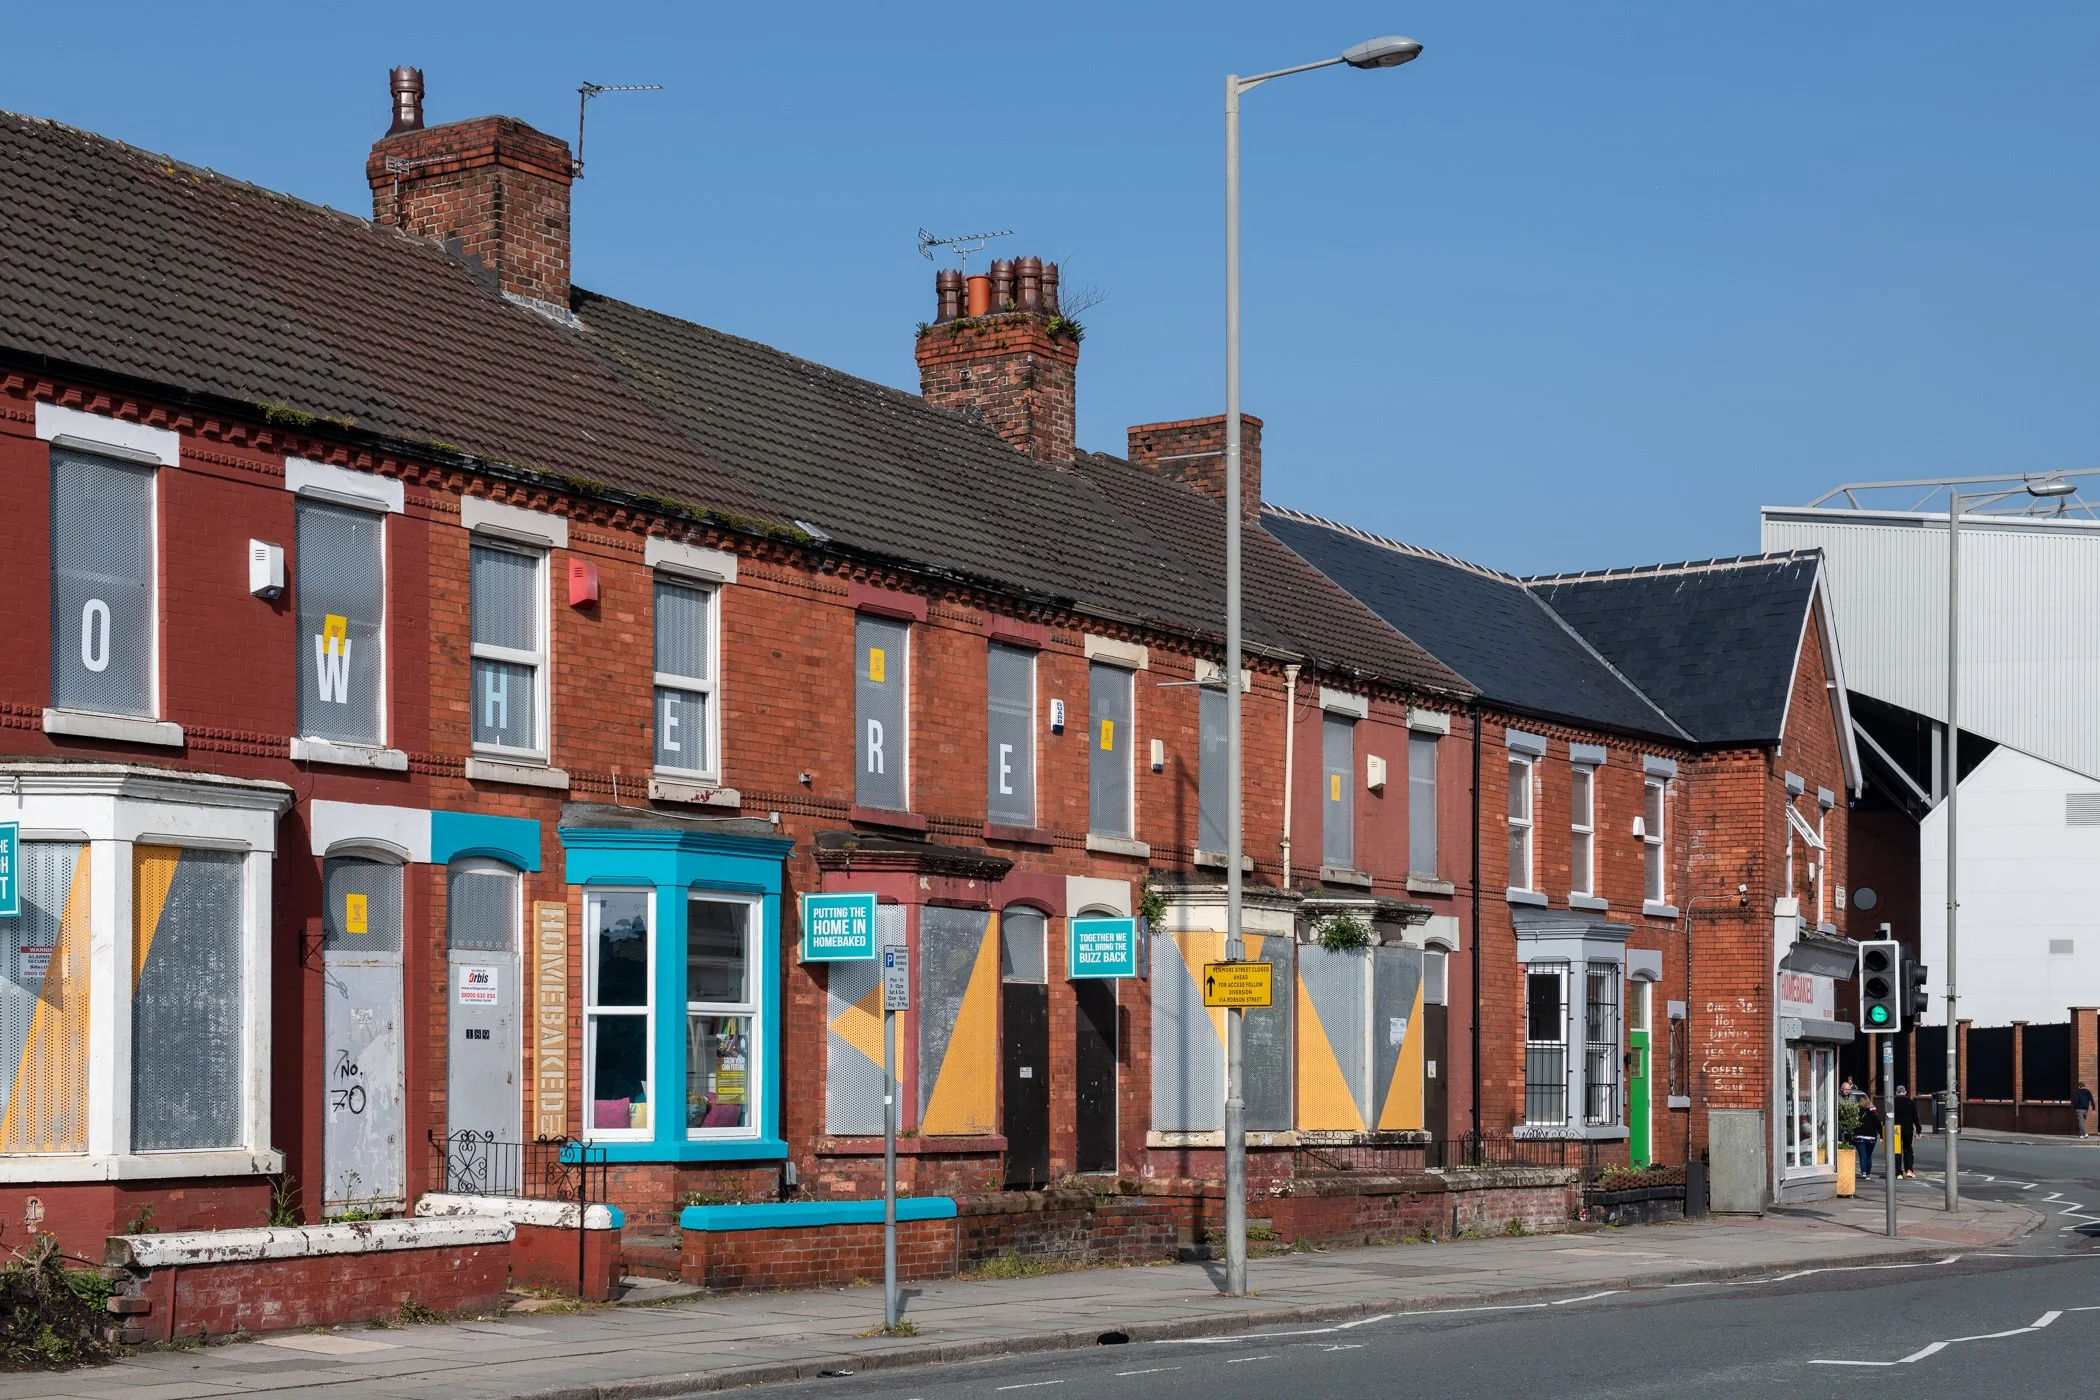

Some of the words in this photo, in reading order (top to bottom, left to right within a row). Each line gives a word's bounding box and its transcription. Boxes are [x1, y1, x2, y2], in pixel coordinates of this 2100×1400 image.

[81, 598, 110, 672] O
[315, 634, 352, 703] W
[485, 662, 508, 729] H
[663, 691, 681, 751] E
[867, 719, 884, 774] R
[1000, 743, 1013, 795] E
[813, 907, 848, 919] PUTTING
[849, 906, 867, 918] THE
[813, 919, 850, 935] HOME
[853, 918, 866, 935] IN
[1079, 933, 1115, 942] TOGETHER
[1115, 932, 1127, 942] WE
[813, 935, 866, 948] HOMEBAKED
[1079, 943, 1094, 951] WILL
[1095, 943, 1114, 951] BRING
[1114, 942, 1127, 951] THE
[887, 954, 892, 967] P
[1079, 952, 1102, 963] BUZZ
[1103, 951, 1127, 963] BACK
[468, 972, 489, 984] Orbis
[1781, 973, 1814, 1004] HOMEBAKED
[541, 908, 564, 1111] HOMEBAKED
[466, 1029, 490, 1039] 189
[331, 1085, 366, 1115] 70
[540, 1113, 564, 1134] CLT
